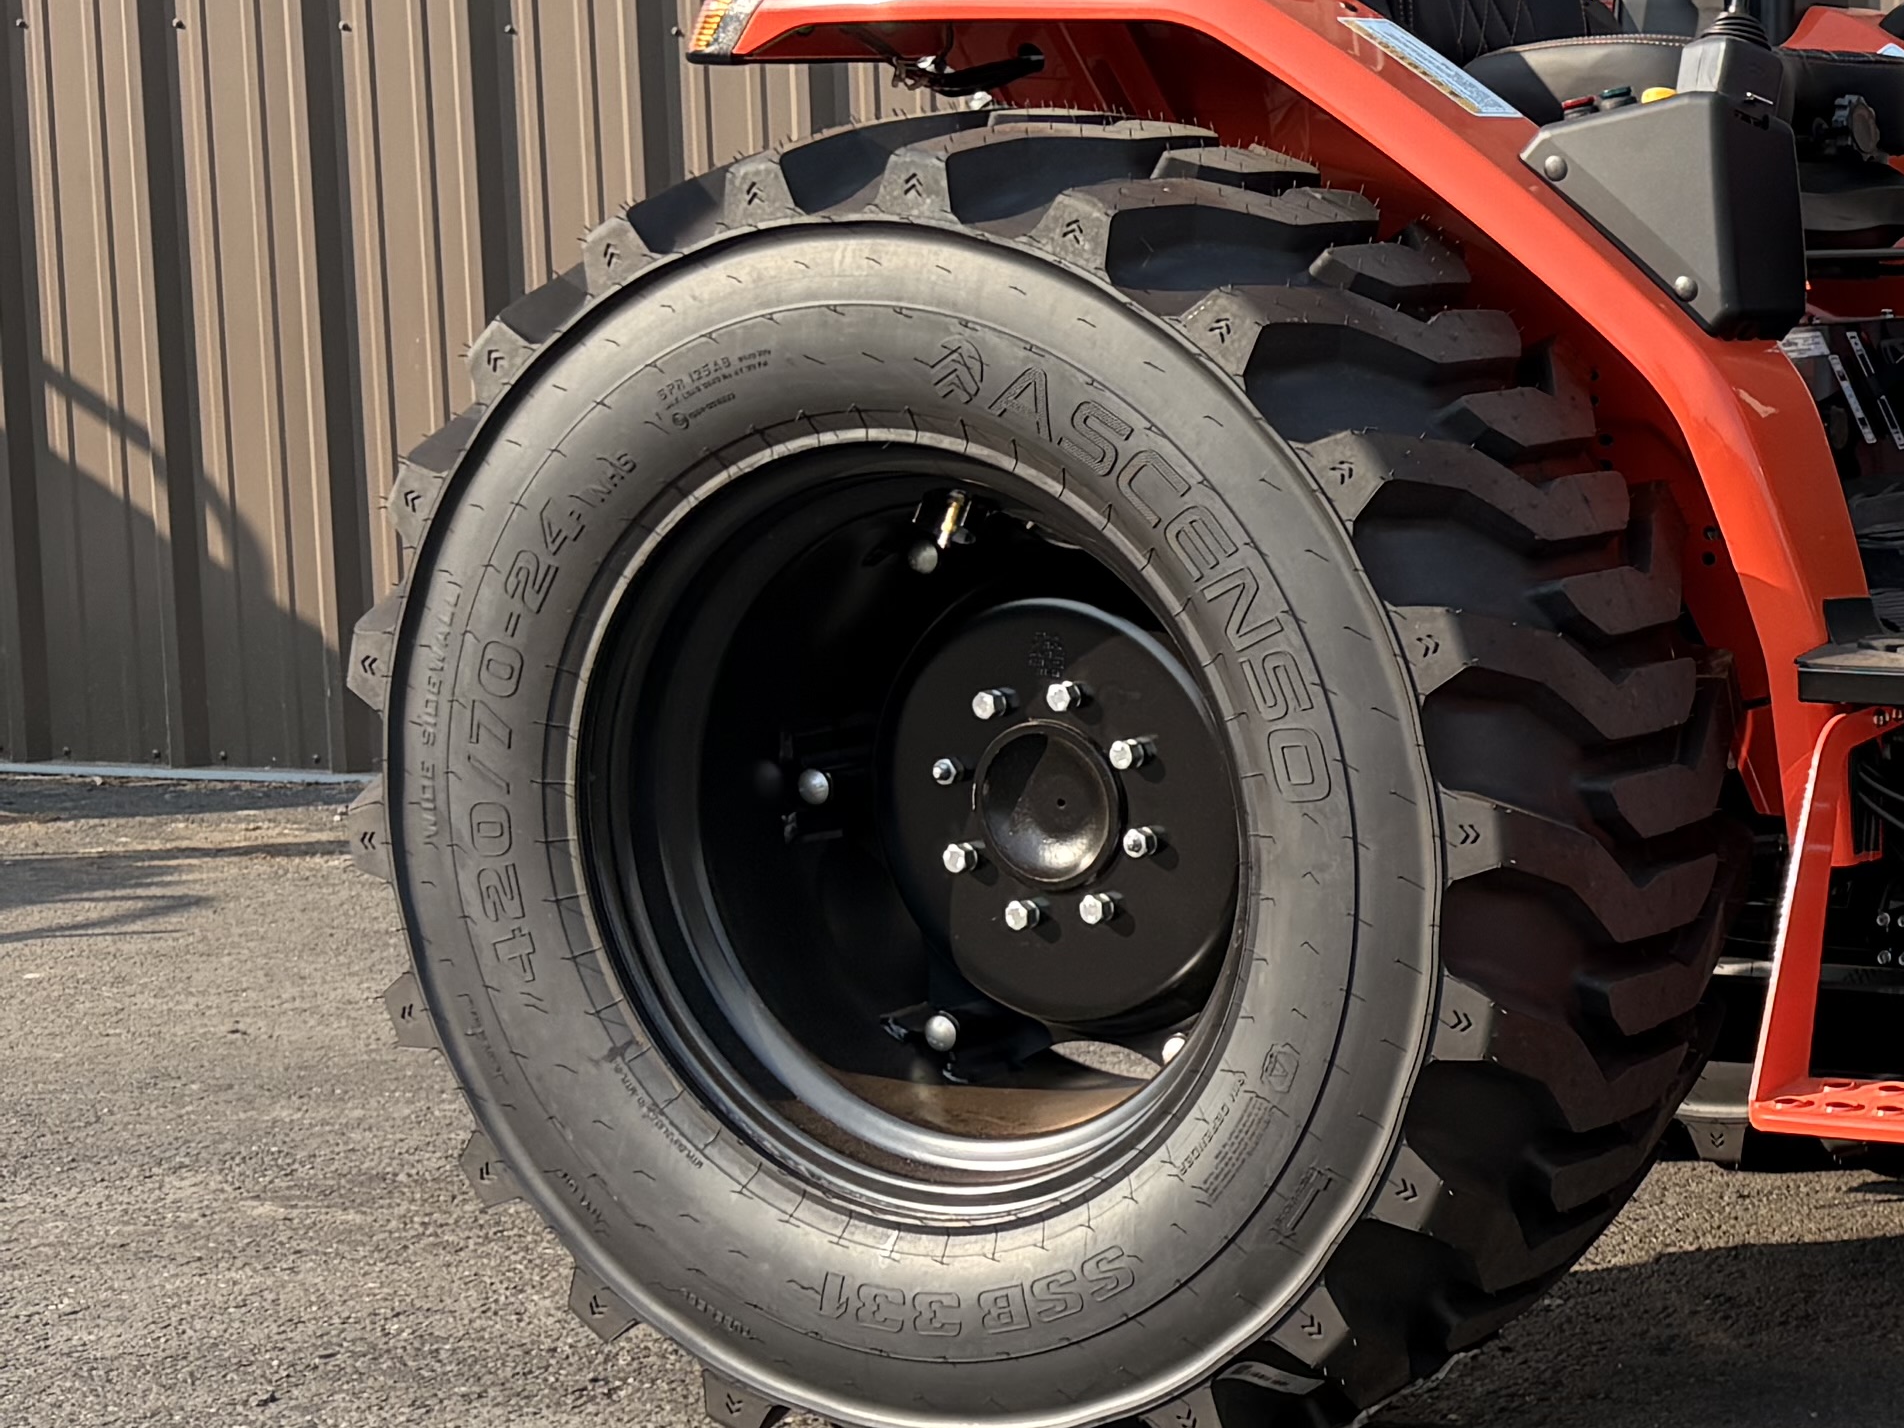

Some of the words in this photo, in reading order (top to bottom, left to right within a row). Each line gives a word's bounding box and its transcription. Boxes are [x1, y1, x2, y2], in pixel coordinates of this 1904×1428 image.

[987, 366, 1332, 804] ASCENSO
[421, 591, 462, 749] SIDEWALL
[818, 1270, 962, 1338] 331
[978, 1244, 1137, 1335] SSB
